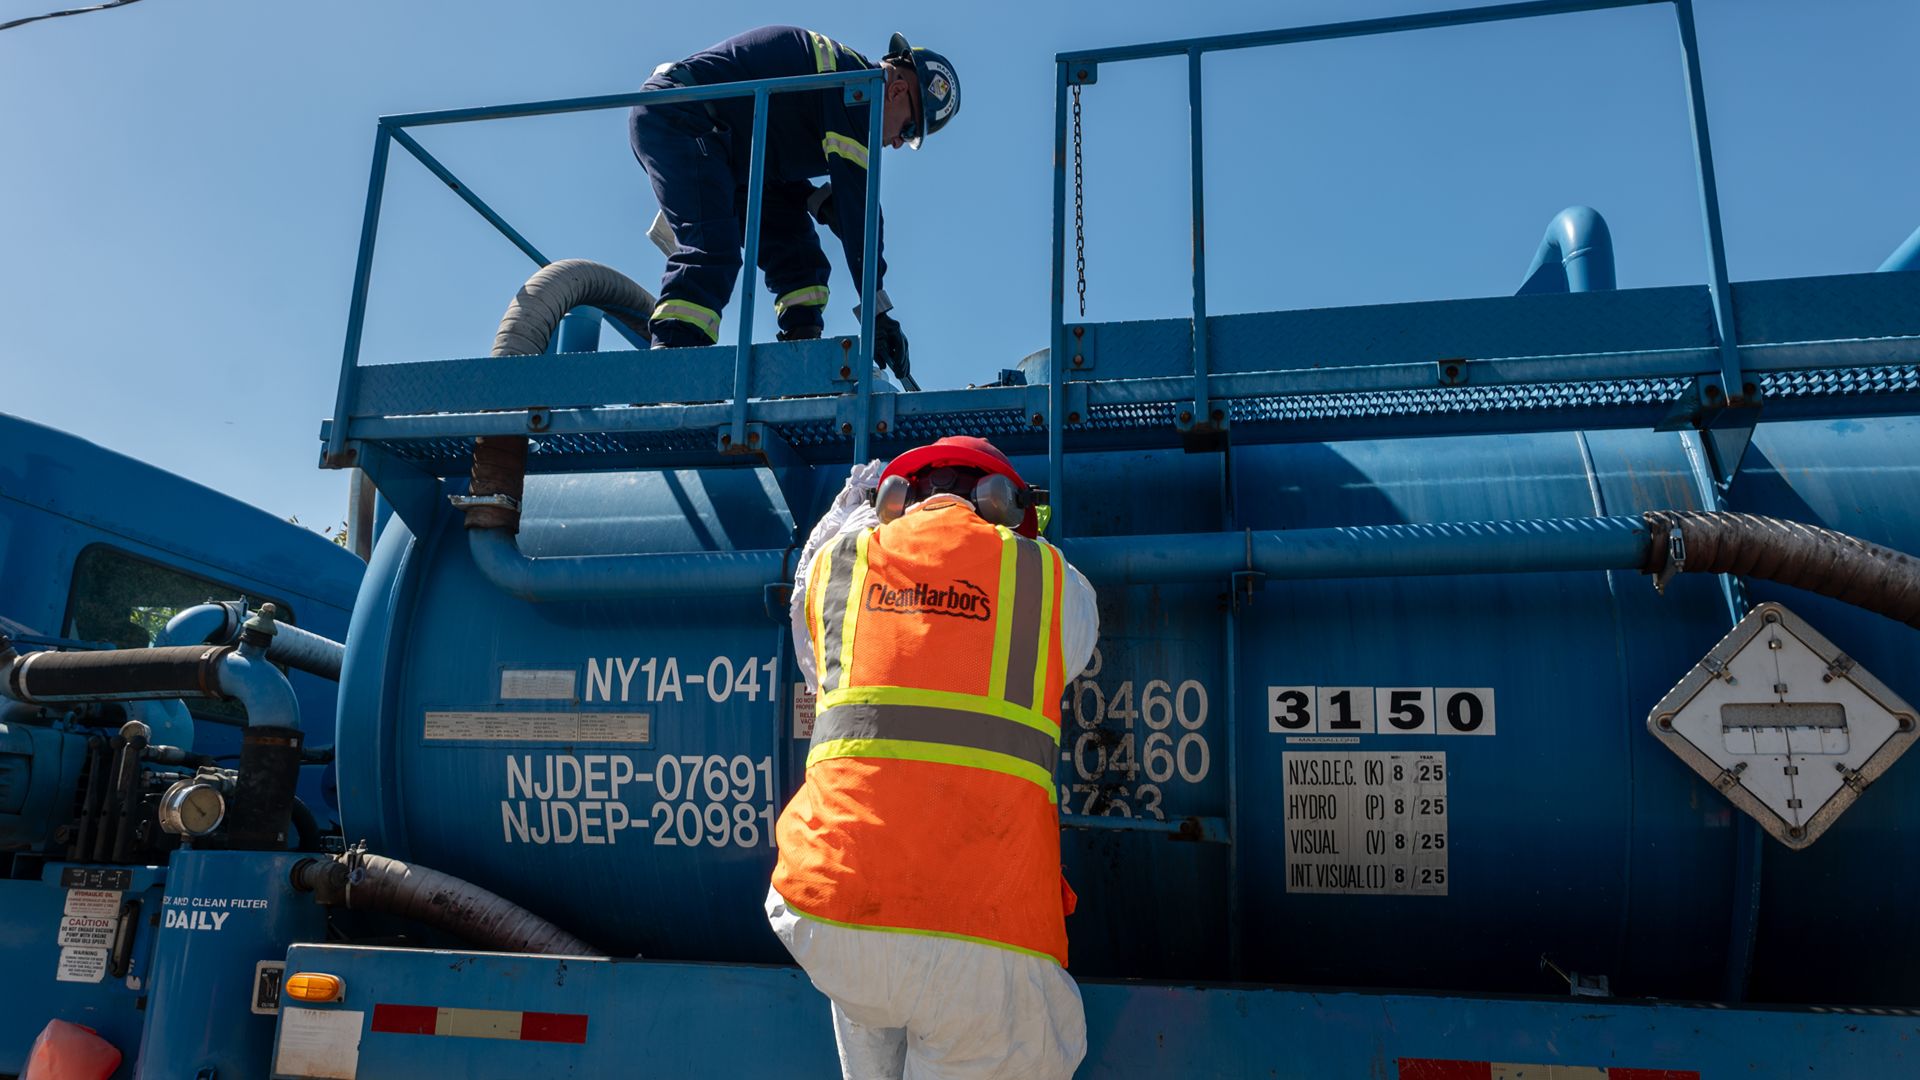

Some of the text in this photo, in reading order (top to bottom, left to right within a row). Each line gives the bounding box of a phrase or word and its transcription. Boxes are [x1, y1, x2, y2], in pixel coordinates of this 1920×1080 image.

[866, 581, 991, 621] CleanHarbors
[585, 656, 777, 702] NY1A-041
[506, 754, 773, 801] NJDEP-07691
[1364, 760, 1384, 786] (K)
[1393, 765, 1404, 782] 8
[1289, 794, 1337, 820] HYDRO
[1366, 794, 1385, 820] (P)
[501, 801, 776, 848] NJDEP-20981
[1290, 829, 1340, 855] VISUAL
[1366, 829, 1386, 855] (V)
[1316, 863, 1365, 889] VISUAL
[1366, 864, 1386, 889] (I)
[173, 896, 189, 906] AND
[192, 897, 227, 908] CLEAN
[231, 898, 268, 909] FILTER
[68, 918, 110, 927] CAUTION
[165, 909, 230, 931] DAILY
[73, 949, 98, 957] WARNING
